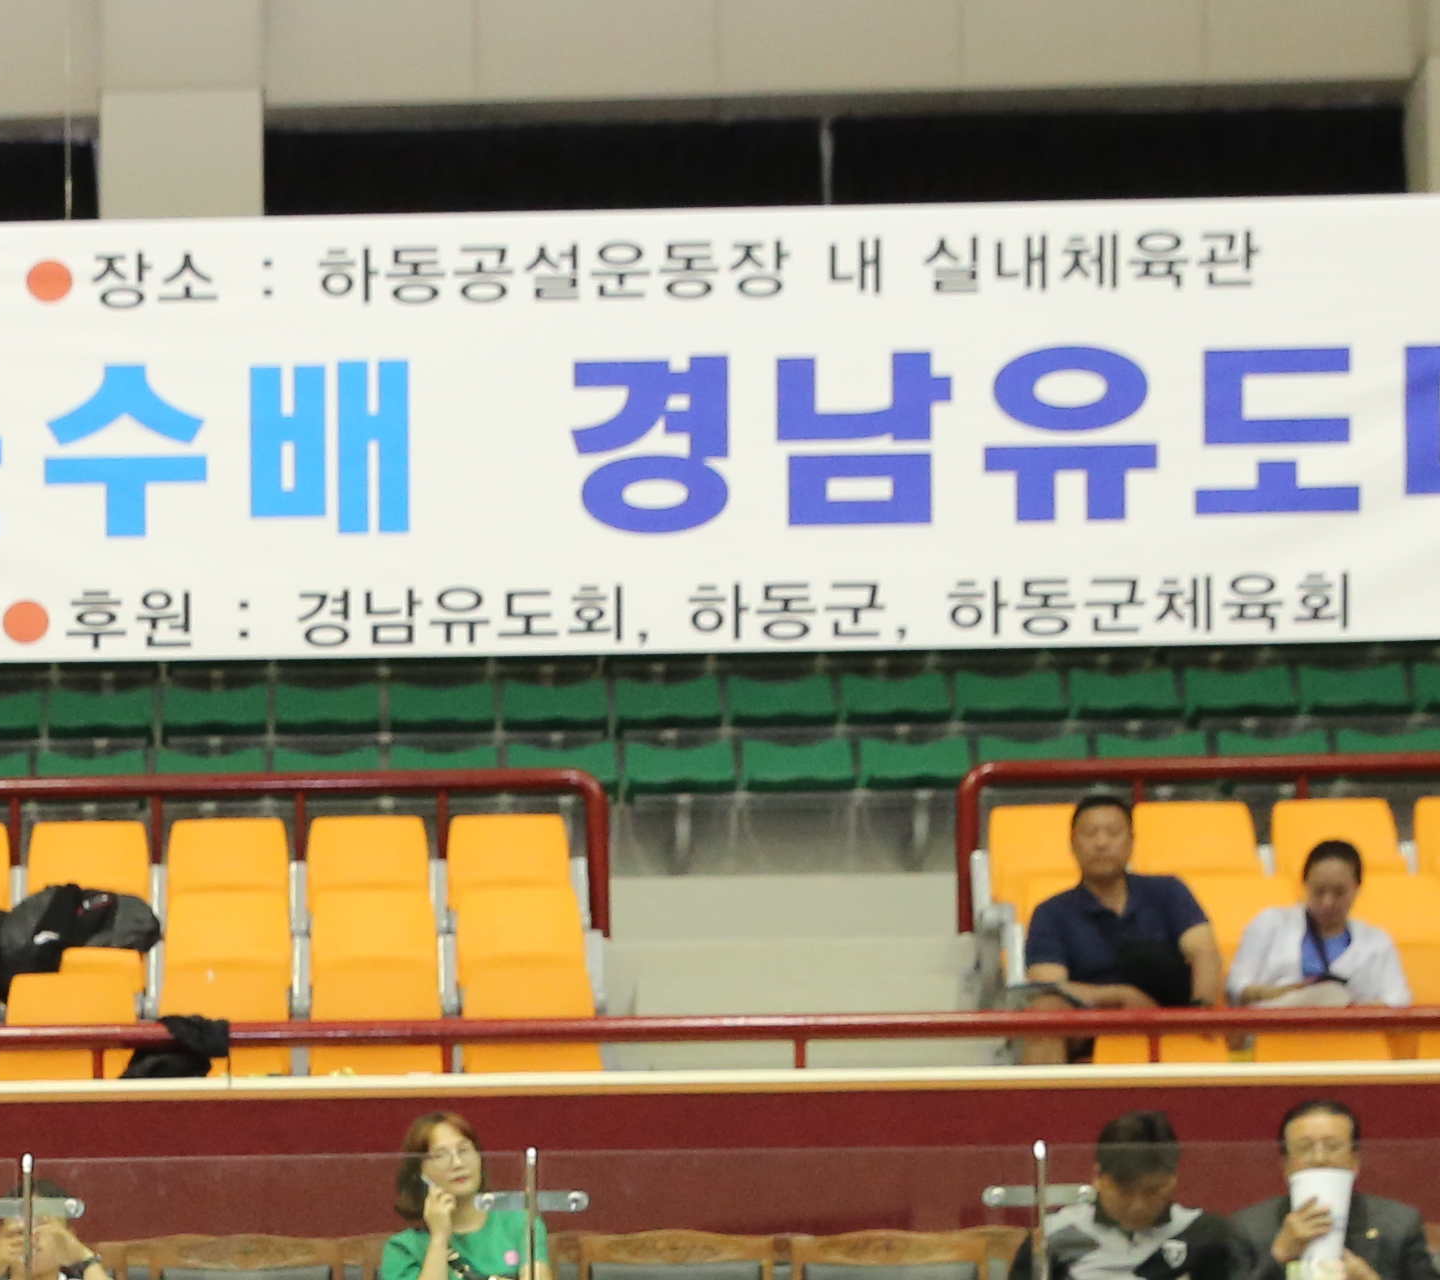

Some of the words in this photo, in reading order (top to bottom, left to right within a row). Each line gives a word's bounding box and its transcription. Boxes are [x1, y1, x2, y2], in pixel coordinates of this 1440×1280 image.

[93, 252, 217, 310] 장소
[320, 240, 790, 305] 하동공설운동장
[830, 239, 882, 295] 내
[926, 231, 1260, 294] 실내체육관
[67, 591, 192, 651] 후원
[299, 586, 653, 651] 경남유도회,
[690, 582, 910, 645] 하동군,
[949, 573, 1352, 637] 하동군체육회
